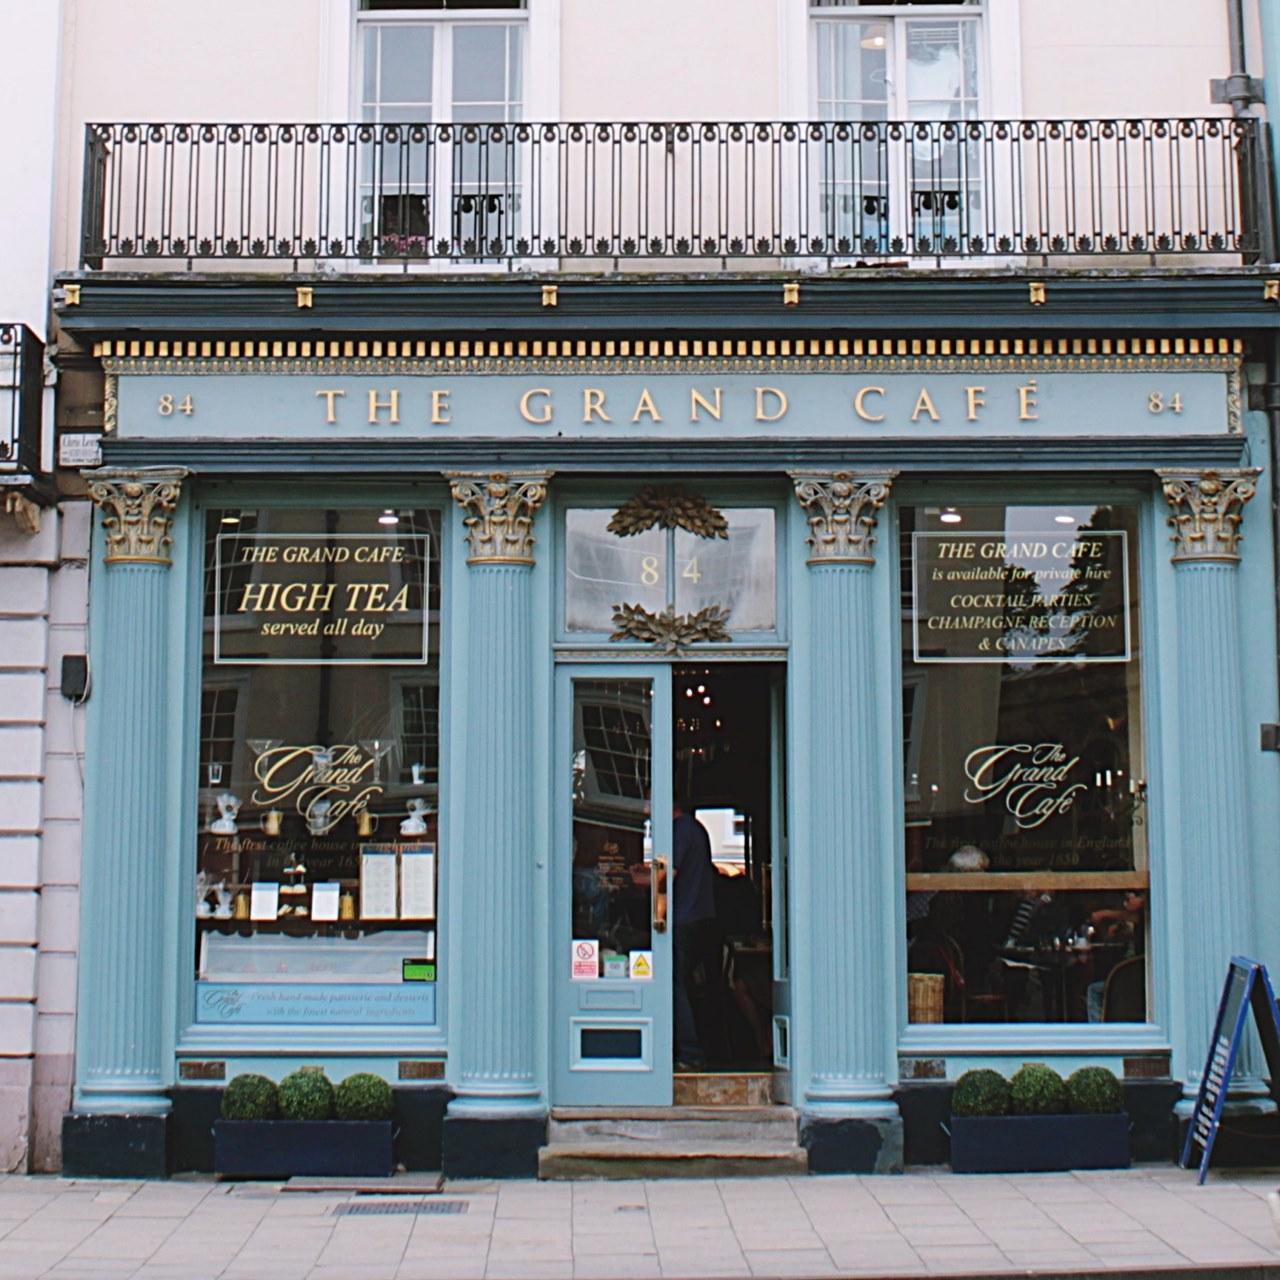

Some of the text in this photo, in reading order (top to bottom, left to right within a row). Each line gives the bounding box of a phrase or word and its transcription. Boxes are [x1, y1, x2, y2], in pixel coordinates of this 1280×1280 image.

[158, 394, 194, 416] 84
[317, 379, 1040, 423] THE GRAND CAFÉ
[1148, 391, 1184, 413] 84
[241, 546, 405, 563] THE GRAND CAFE
[938, 542, 1103, 559] THE GRAND CAFE
[932, 565, 1112, 584] is available for private hire
[237, 583, 409, 612] HIGH TEA
[950, 593, 1094, 609] COCKTAIL PARTIES
[261, 618, 384, 640] served all day
[927, 614, 1118, 630] CHAMPAGNE RECEPTION
[978, 637, 1067, 651] & CANAPES
[327, 744, 362, 766] The
[1032, 742, 1066, 765] The
[252, 745, 375, 805] Grand
[964, 744, 1080, 804] Grand
[296, 784, 383, 832] Café
[1006, 783, 1088, 829] Café
